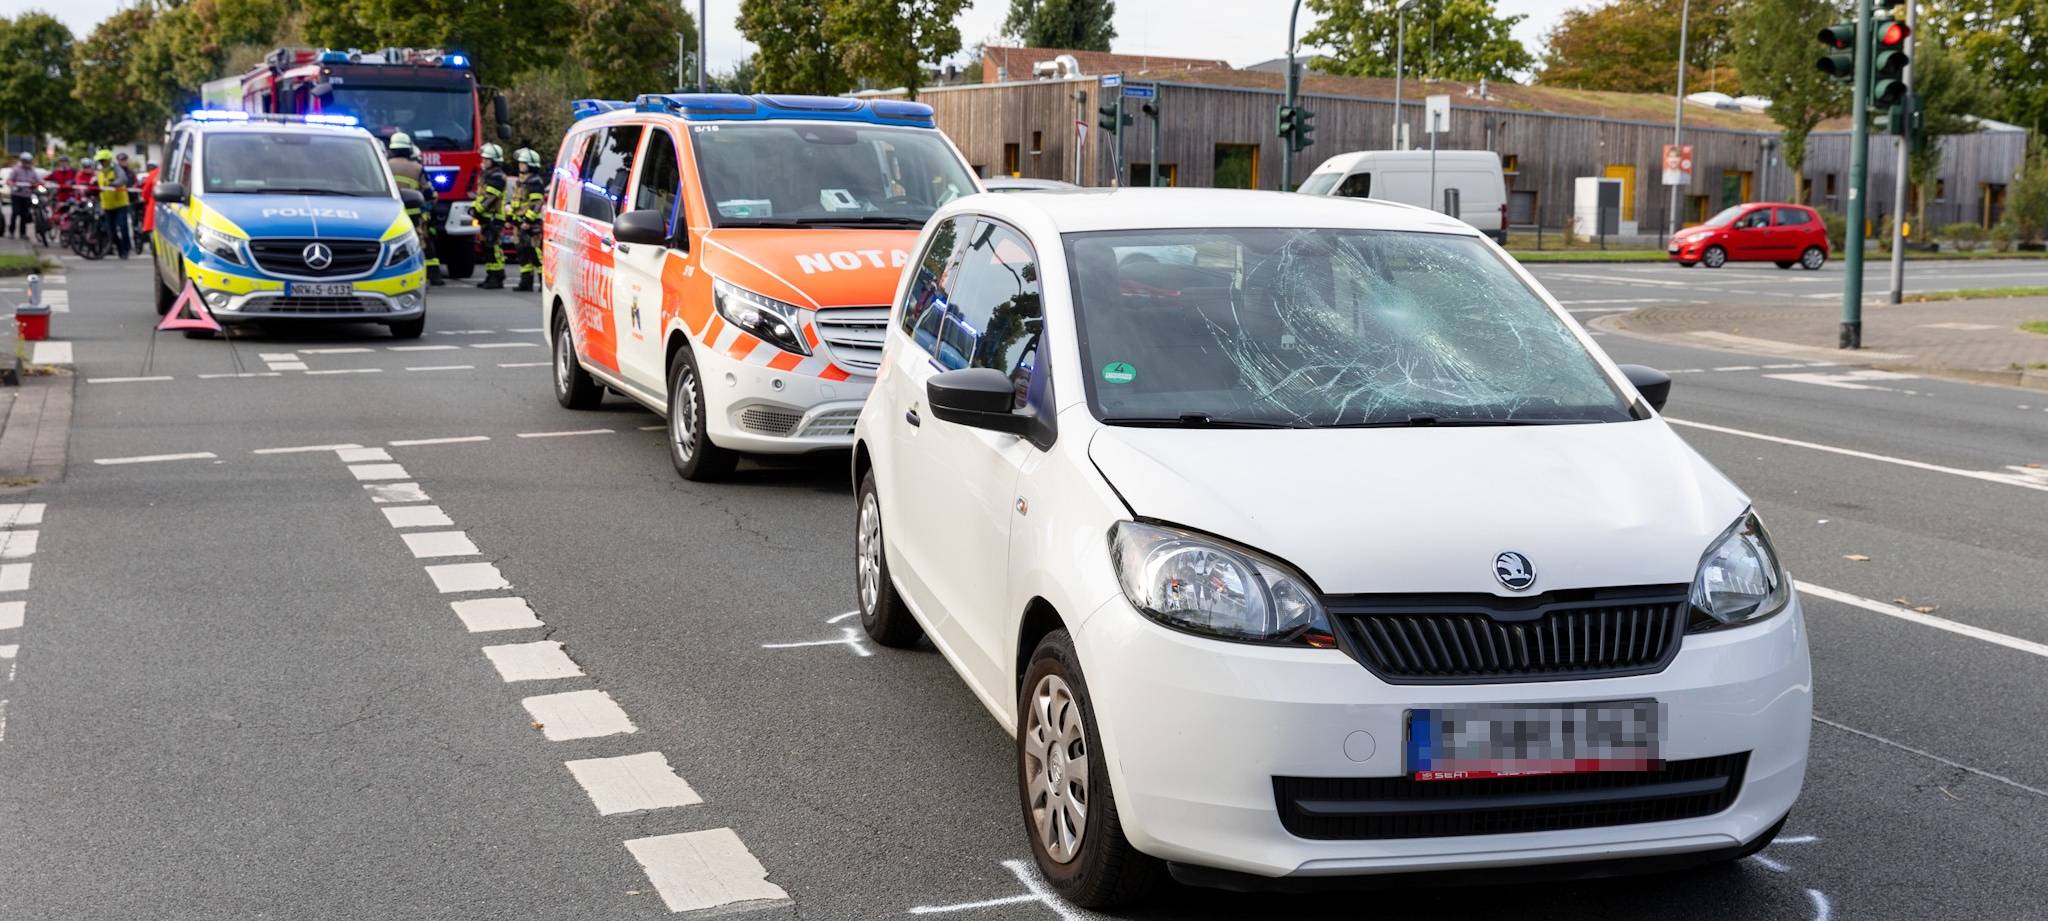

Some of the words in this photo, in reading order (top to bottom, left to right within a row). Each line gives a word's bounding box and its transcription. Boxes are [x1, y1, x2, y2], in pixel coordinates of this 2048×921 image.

[262, 207, 360, 219] POLIZEI
[795, 249, 909, 275] NOTA
[1113, 363, 1125, 373] 4
